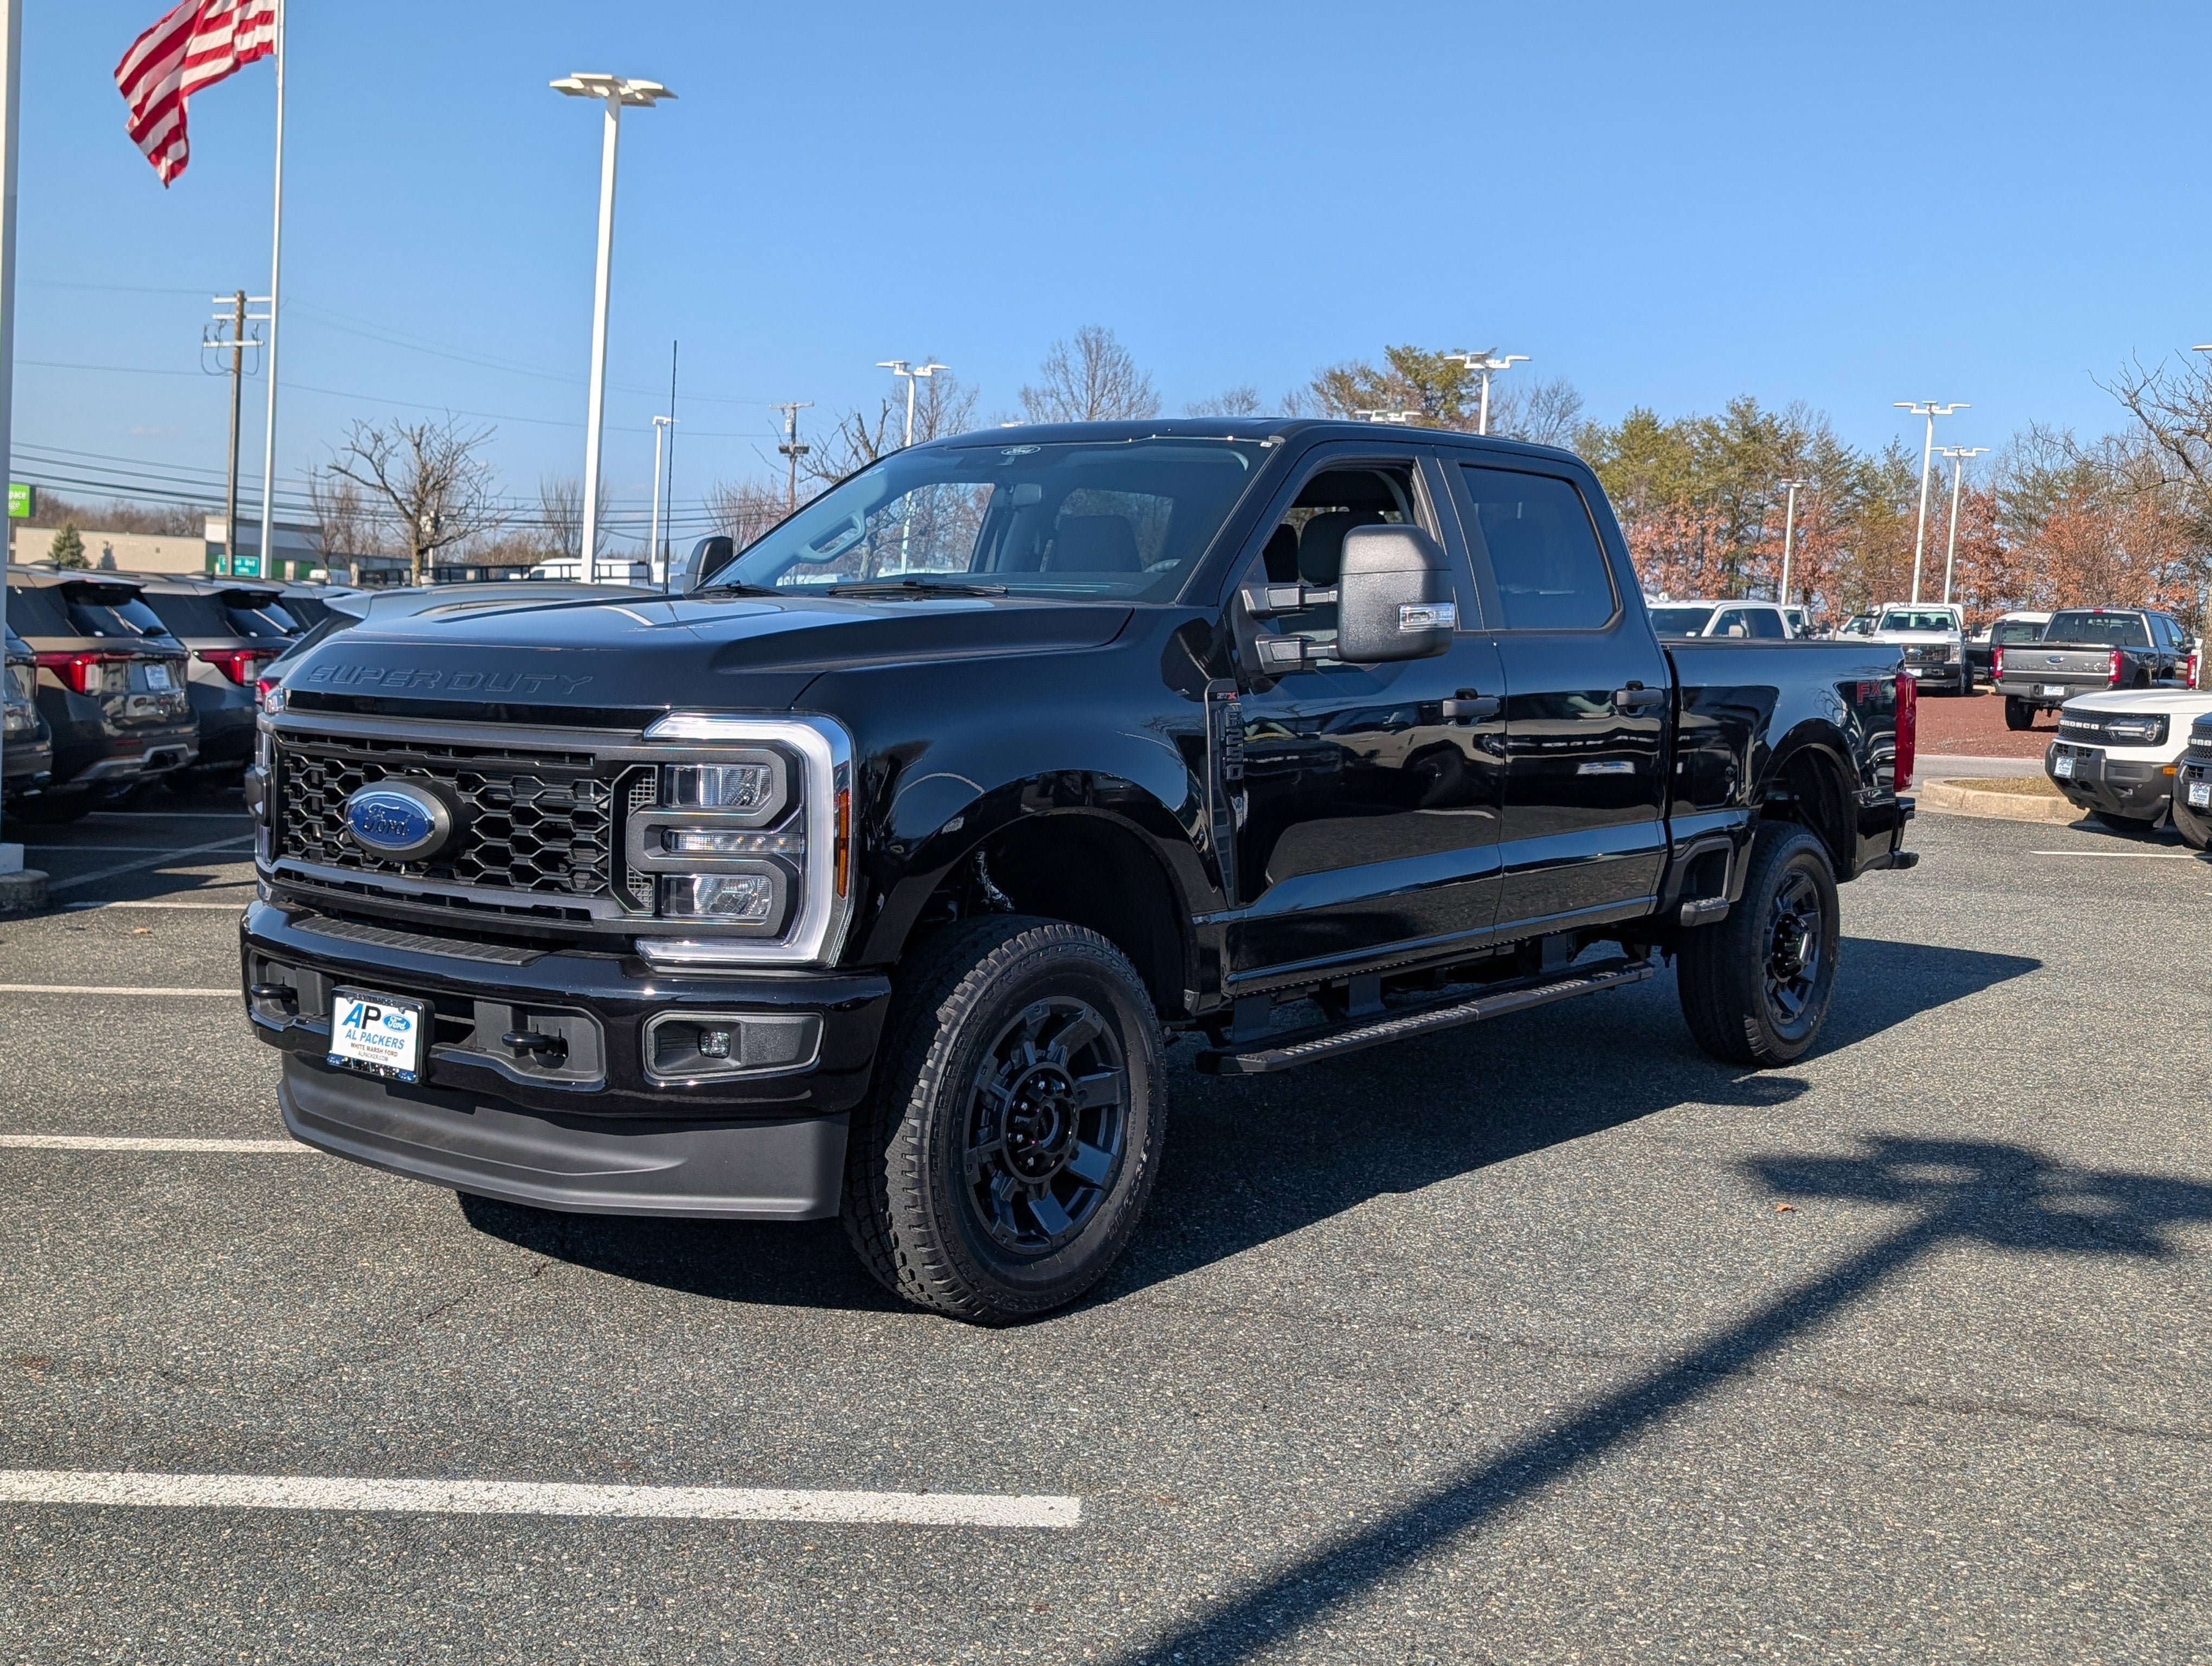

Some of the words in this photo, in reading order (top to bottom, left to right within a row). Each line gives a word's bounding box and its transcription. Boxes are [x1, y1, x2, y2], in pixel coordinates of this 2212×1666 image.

[307, 664, 442, 689] SUPER
[446, 671, 593, 695] DUTY
[364, 802, 411, 837] Ford
[342, 1003, 382, 1029] AP
[345, 1029, 357, 1040] AL
[359, 1031, 405, 1049] PACKERS
[366, 1045, 383, 1054] MARSH
